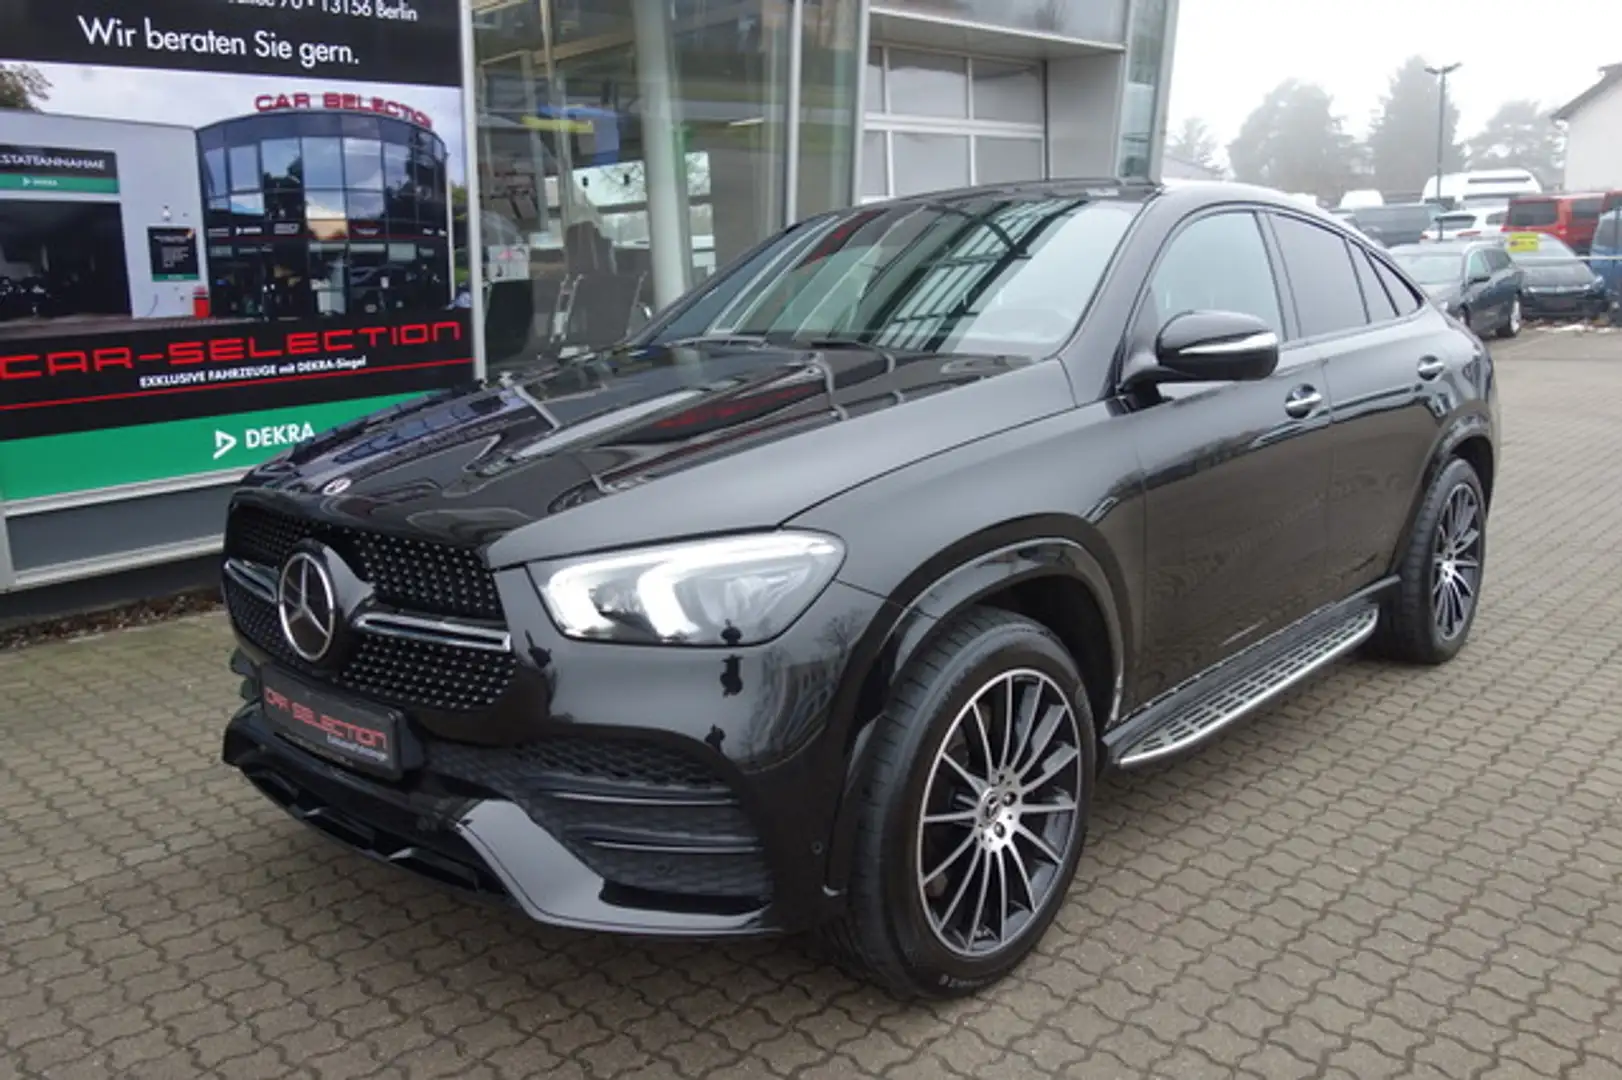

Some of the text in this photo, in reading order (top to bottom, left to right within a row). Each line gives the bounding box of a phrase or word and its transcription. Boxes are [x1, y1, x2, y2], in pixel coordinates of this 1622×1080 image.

[376, 0, 418, 21] Berlin
[78, 15, 360, 68] Wir beraten Sie gern.
[255, 93, 311, 112] CAR
[0, 321, 461, 379] CAR-SELECTION
[139, 371, 206, 388] EXKLUSIVE
[208, 364, 277, 382] FAHRZEUGE
[245, 420, 316, 450] DEKRA
